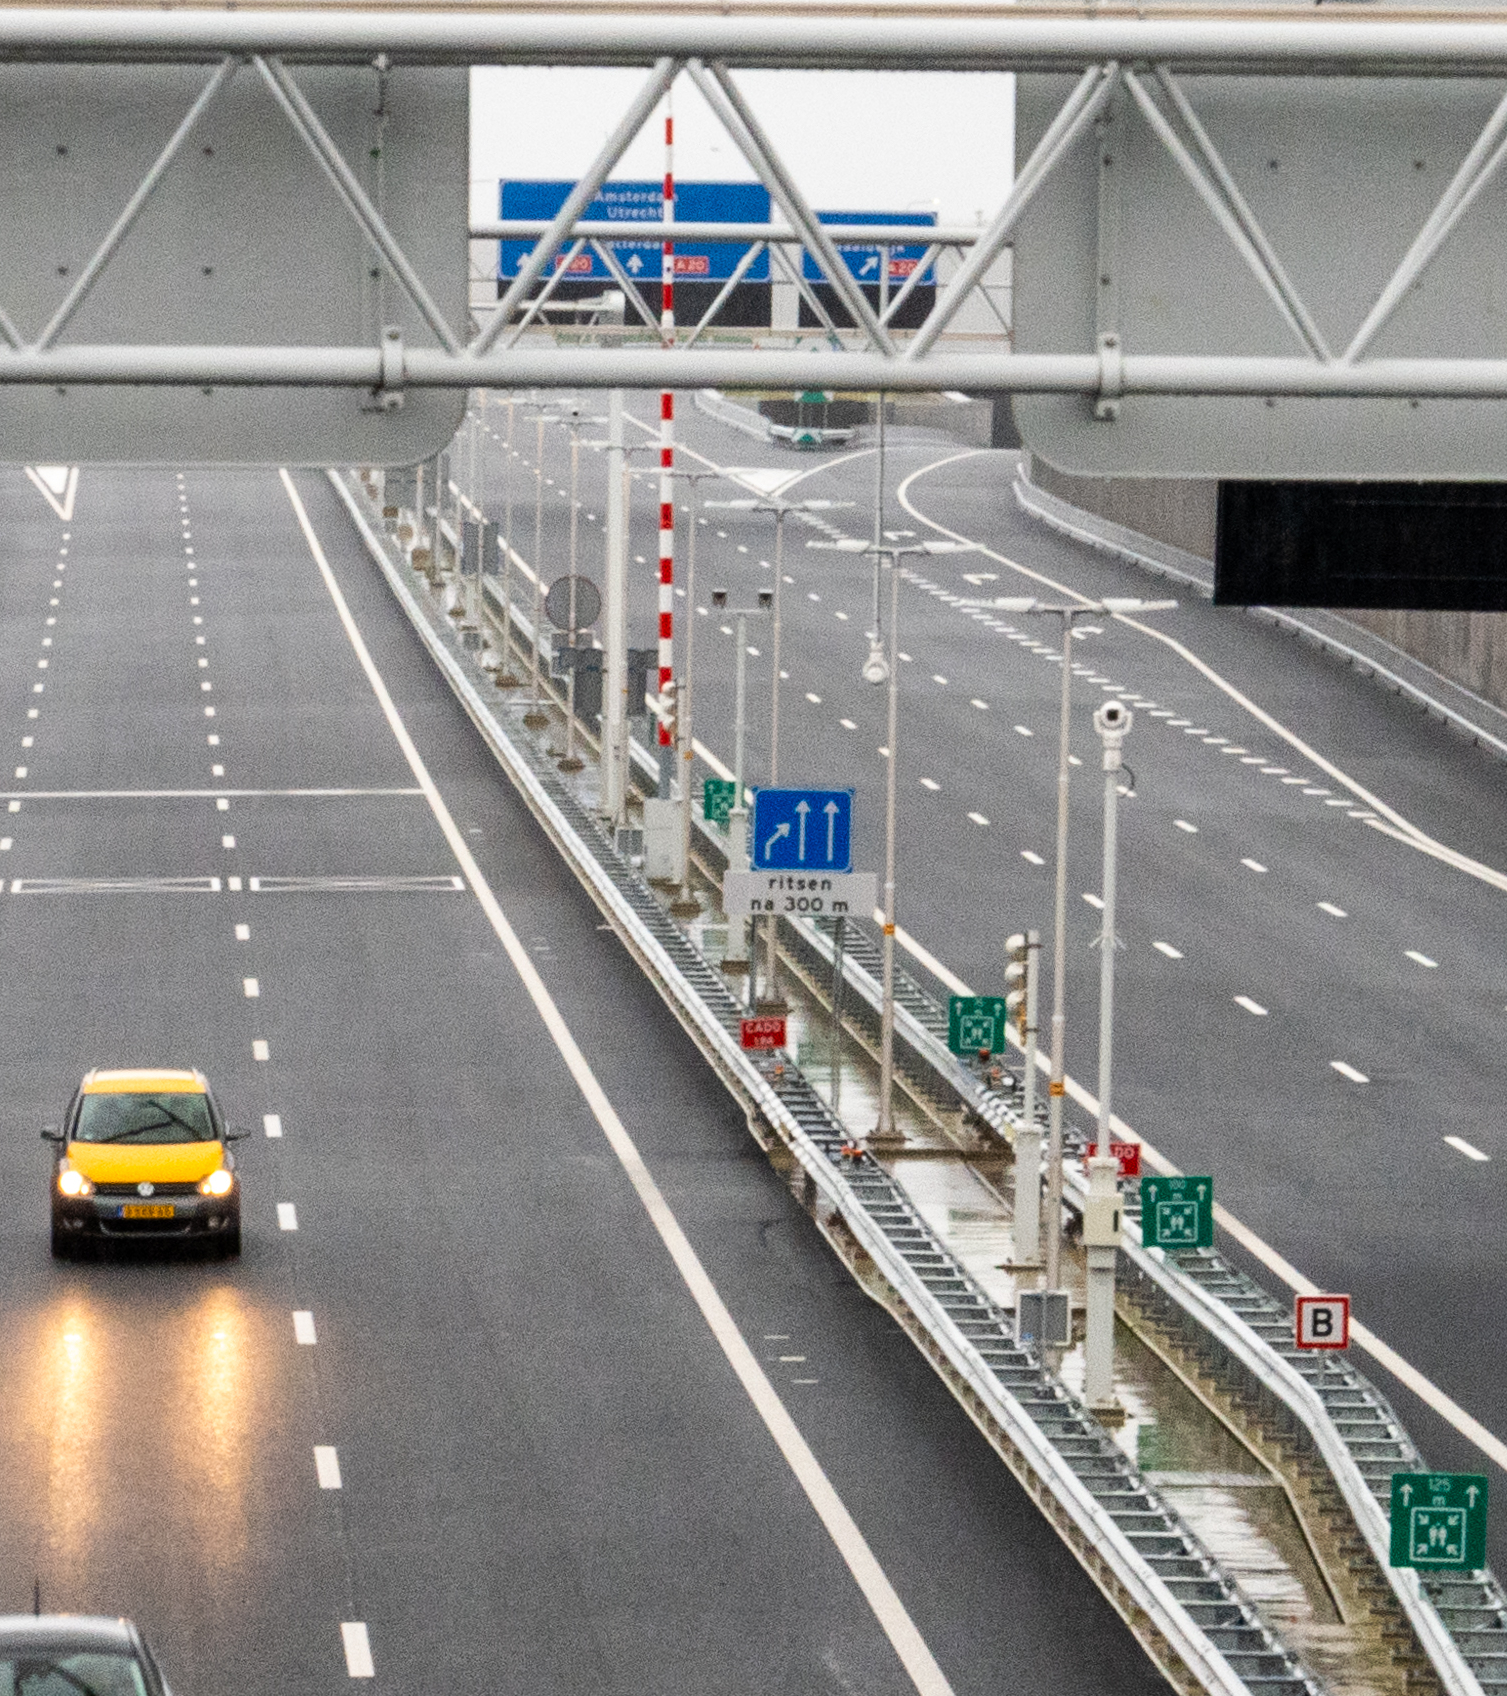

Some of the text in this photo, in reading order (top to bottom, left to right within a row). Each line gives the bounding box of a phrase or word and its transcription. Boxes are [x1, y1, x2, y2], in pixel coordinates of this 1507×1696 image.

[768, 876, 832, 891] ritsen
[751, 897, 849, 912] na 300 m
[1312, 1308, 1333, 1338] B
